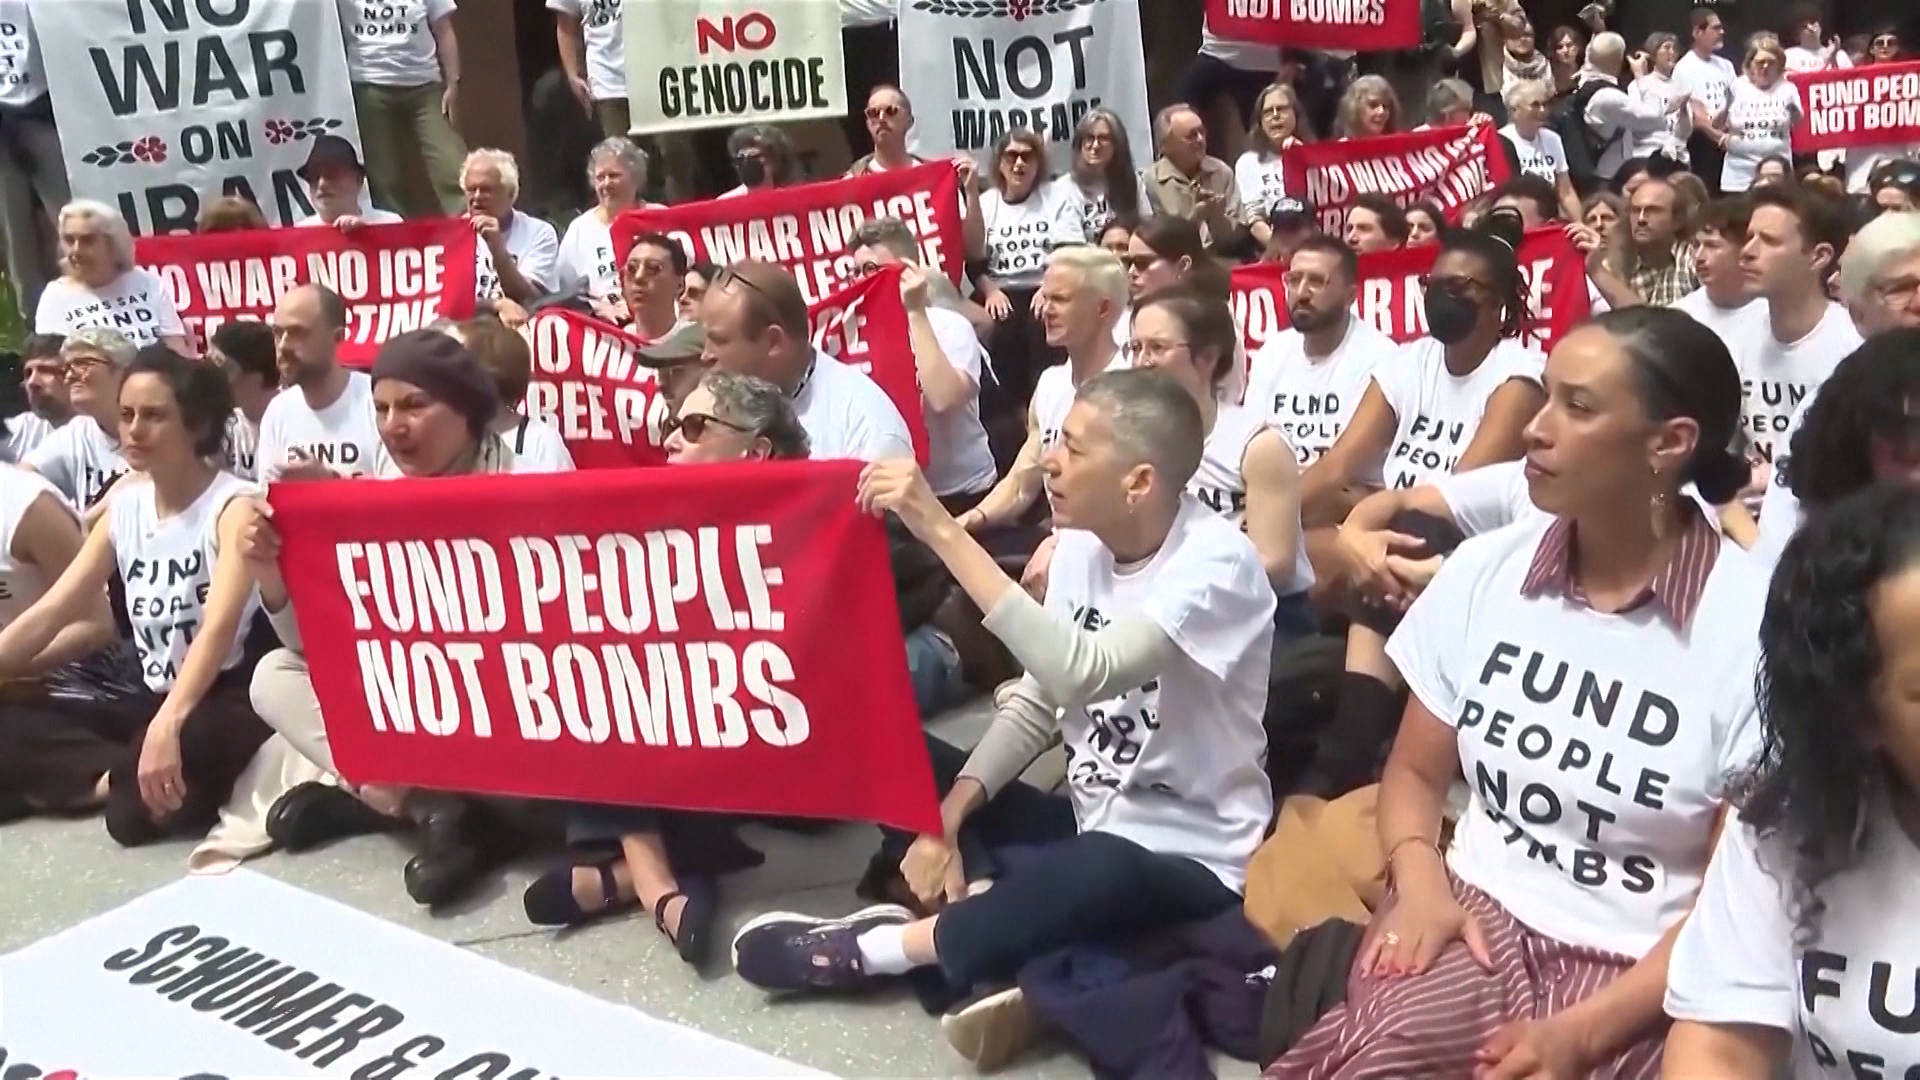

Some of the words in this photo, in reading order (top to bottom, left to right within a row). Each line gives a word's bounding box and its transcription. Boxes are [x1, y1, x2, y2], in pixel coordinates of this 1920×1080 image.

[364, 6, 408, 20] NOT
[697, 12, 776, 54] NO
[1289, 0, 1385, 26] BOMBS
[89, 29, 306, 116] WAR
[659, 57, 829, 119] GENOCIDE
[953, 25, 1094, 100] NOT
[1809, 78, 1869, 109] FUND
[1873, 72, 1920, 102] PEO
[180, 119, 253, 165] ON
[1810, 104, 1859, 136] NOT
[1864, 99, 1920, 130] BOM
[1306, 164, 1349, 205] NO
[1346, 156, 1416, 196] WAR
[701, 214, 804, 265] WAR
[998, 252, 1041, 270] NOT
[65, 300, 112, 322] JEWS
[116, 291, 148, 307] SAY
[196, 254, 299, 310] WAR
[307, 250, 368, 300] NO
[379, 245, 446, 299] ICE
[336, 538, 506, 634] FUND
[509, 523, 785, 634] PEOPLE
[356, 639, 492, 738] NOT
[501, 640, 810, 748] BOMBS
[1479, 641, 1680, 747] FUND
[1457, 699, 1670, 811] PEOPLE
[1476, 760, 1616, 842] NOT
[104, 924, 404, 1069] SCHUMER
[1802, 950, 1920, 1035] FU
